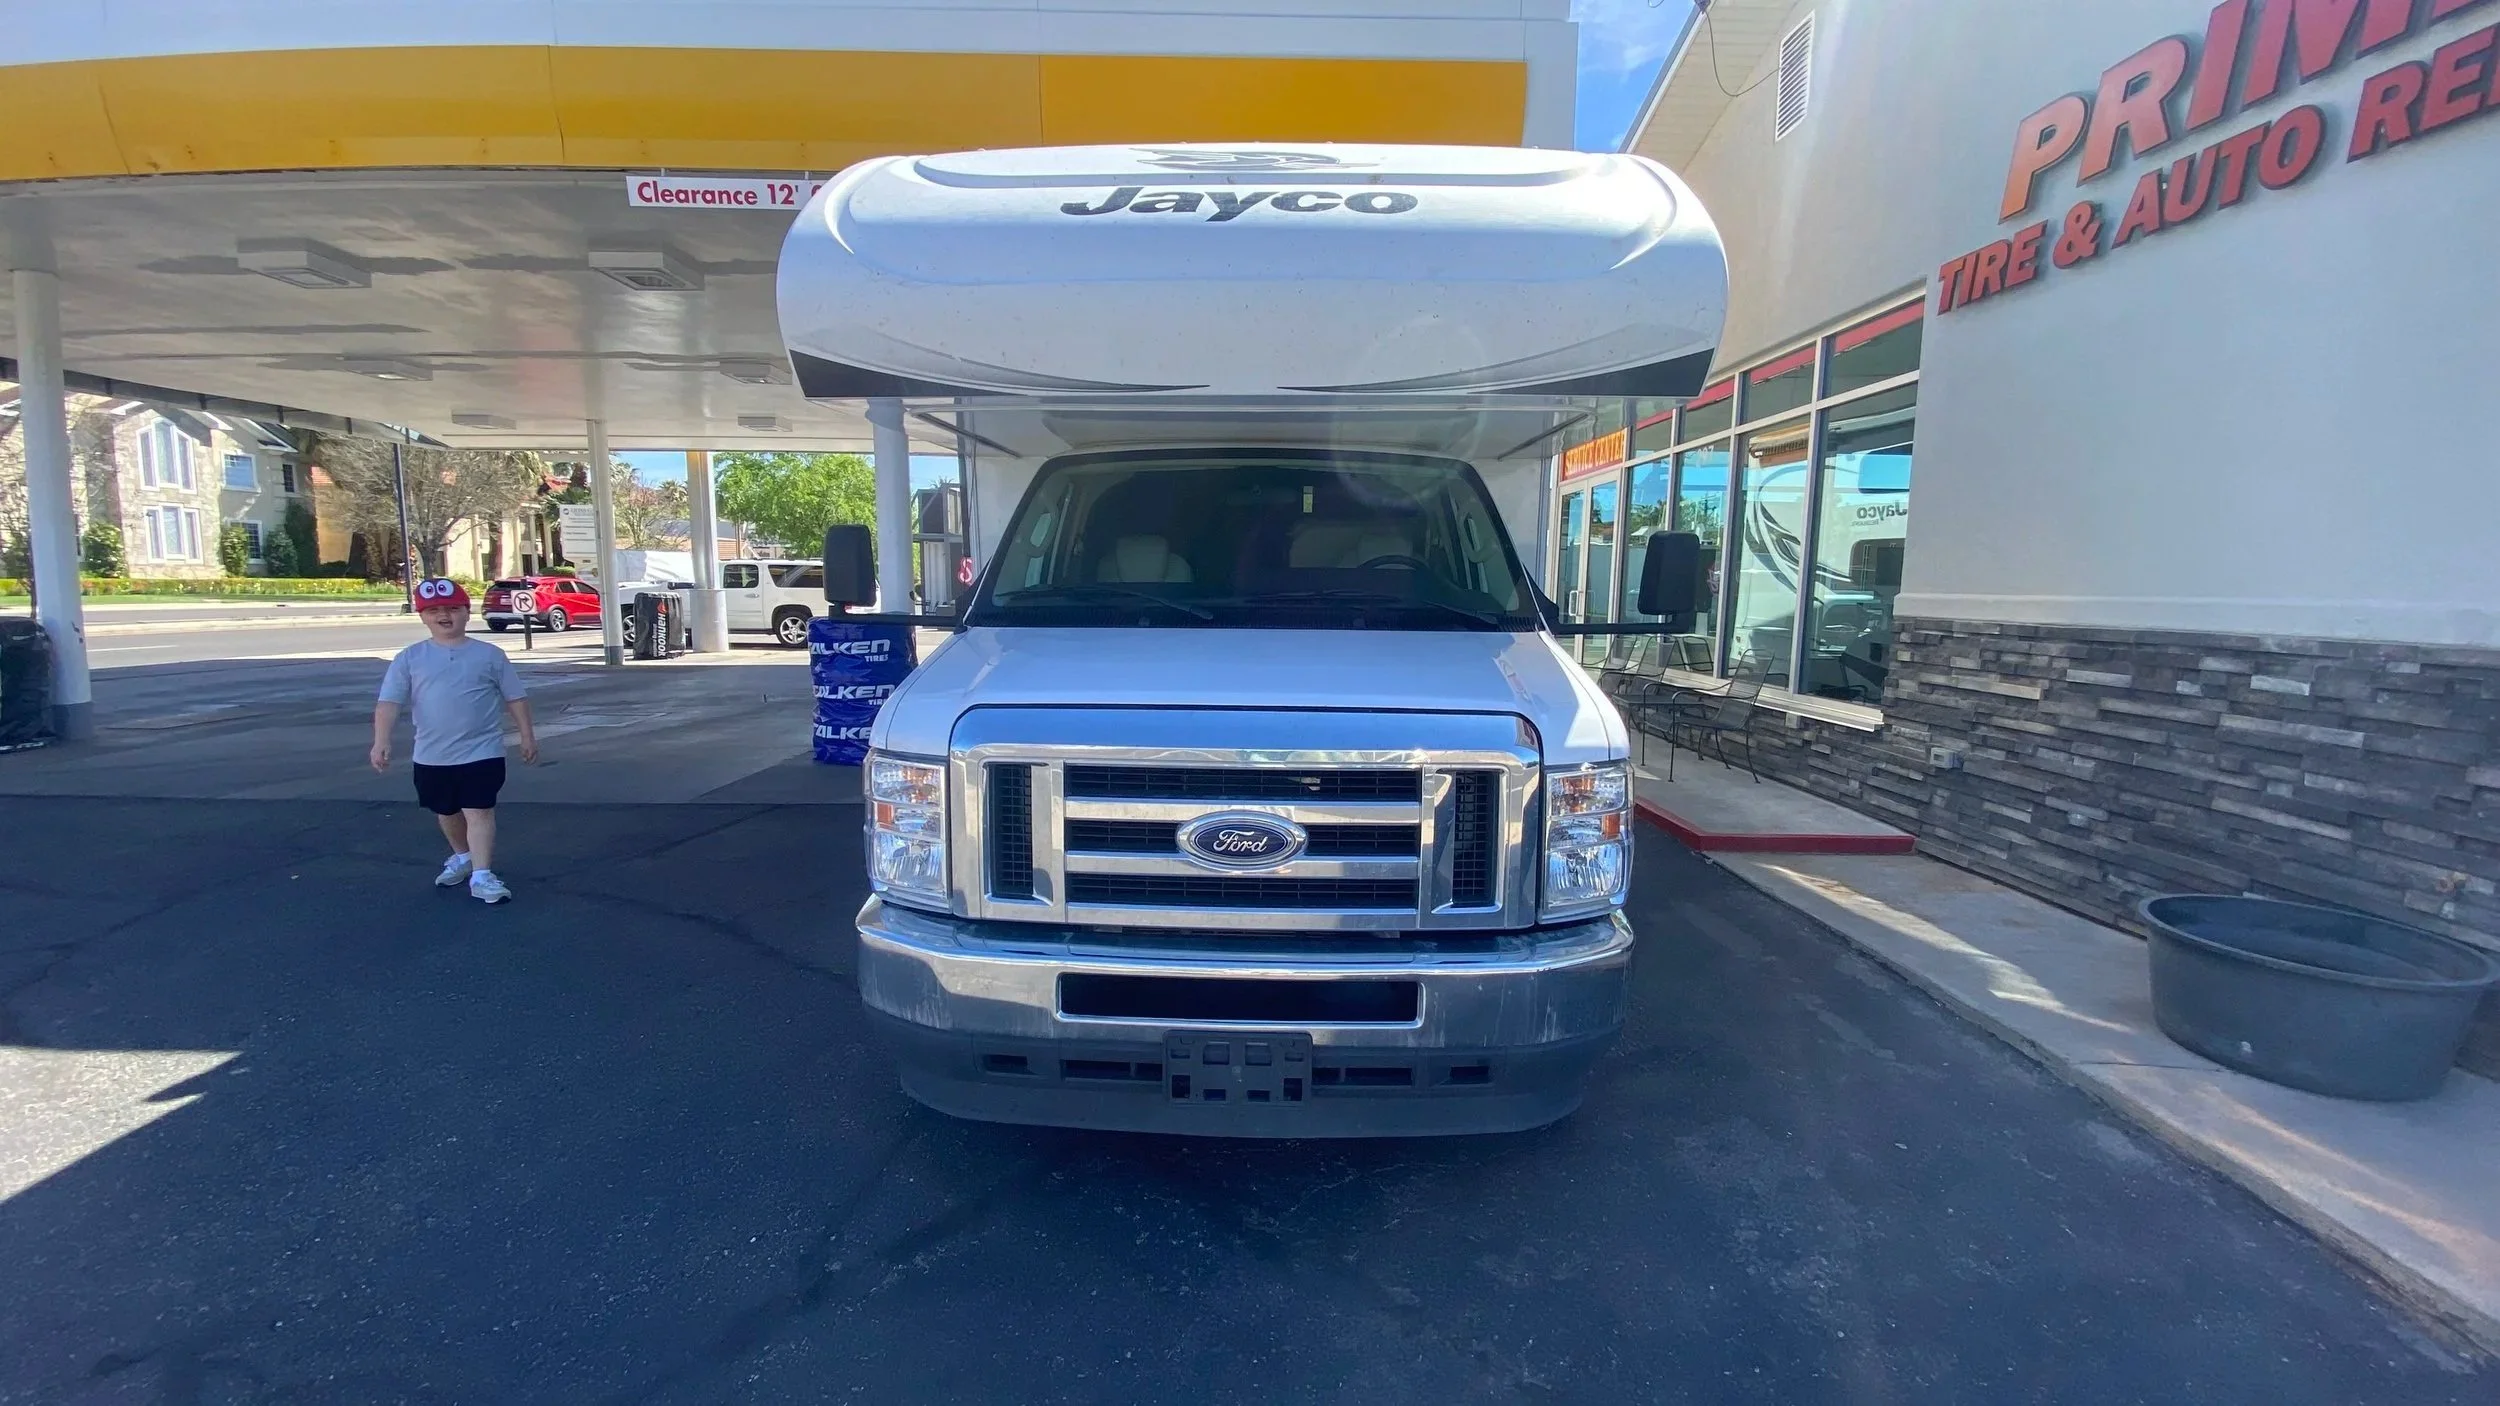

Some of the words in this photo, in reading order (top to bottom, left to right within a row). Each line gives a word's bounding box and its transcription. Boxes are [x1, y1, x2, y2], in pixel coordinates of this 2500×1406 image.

[1998, 0, 2500, 224] PRIM
[1937, 219, 2048, 316] TIRE
[2053, 200, 2103, 270] &
[2111, 105, 2327, 249] AUTO
[2347, 22, 2500, 163] RE
[637, 181, 758, 205] Clearance
[767, 183, 799, 205] 12'
[1060, 186, 1418, 222] Jayco
[1565, 440, 1595, 475] SERVICE
[864, 654, 889, 662] TIRES
[1213, 829, 1269, 853] Ford
